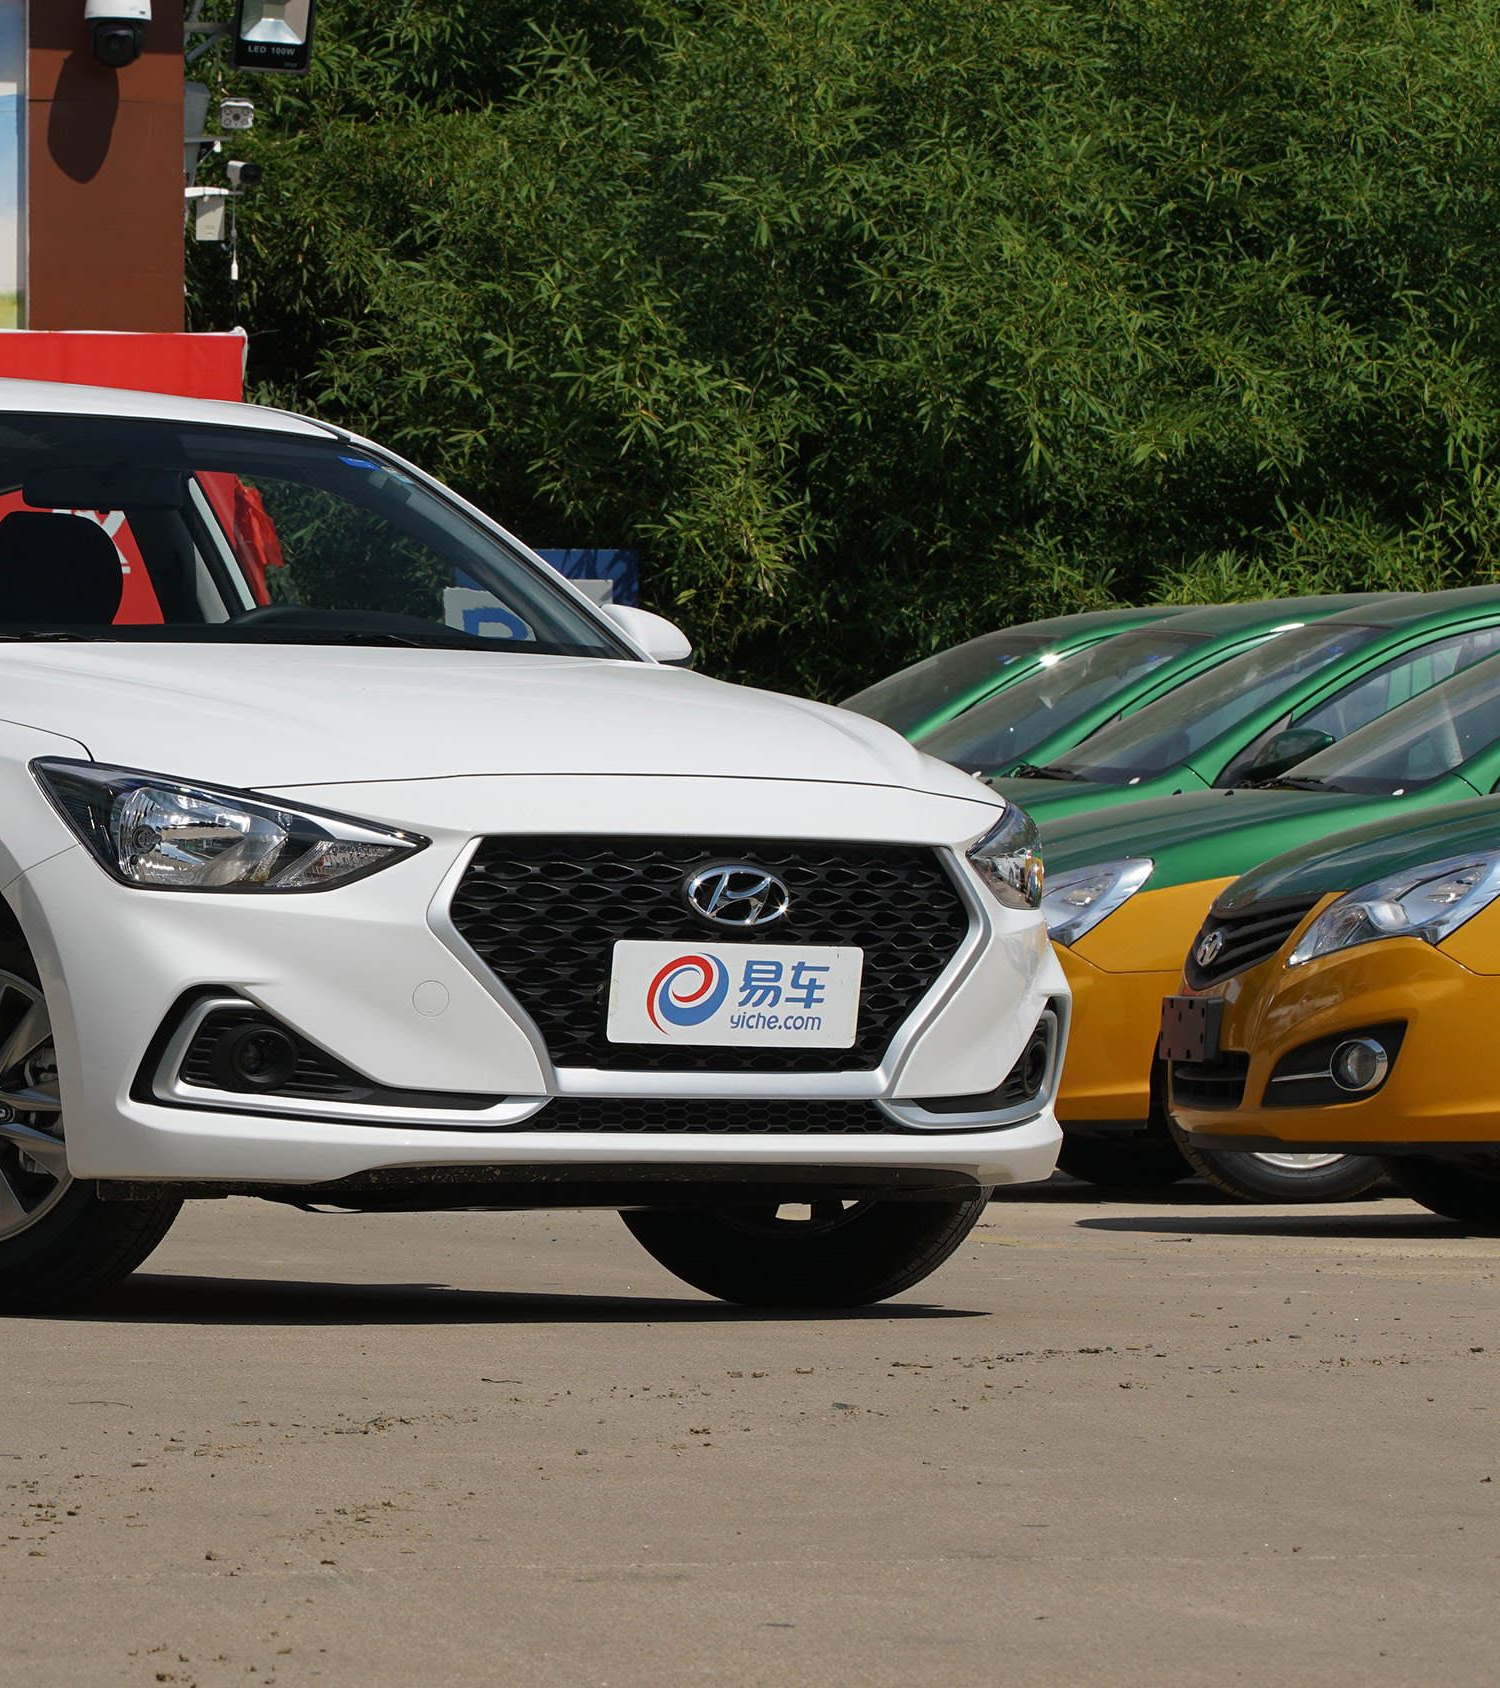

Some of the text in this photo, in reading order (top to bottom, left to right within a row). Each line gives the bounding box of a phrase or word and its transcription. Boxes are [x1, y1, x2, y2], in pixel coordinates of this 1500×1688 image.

[248, 45, 296, 55] LED 100W
[738, 960, 830, 1009] 易车
[730, 1012, 822, 1031] yiche.com
